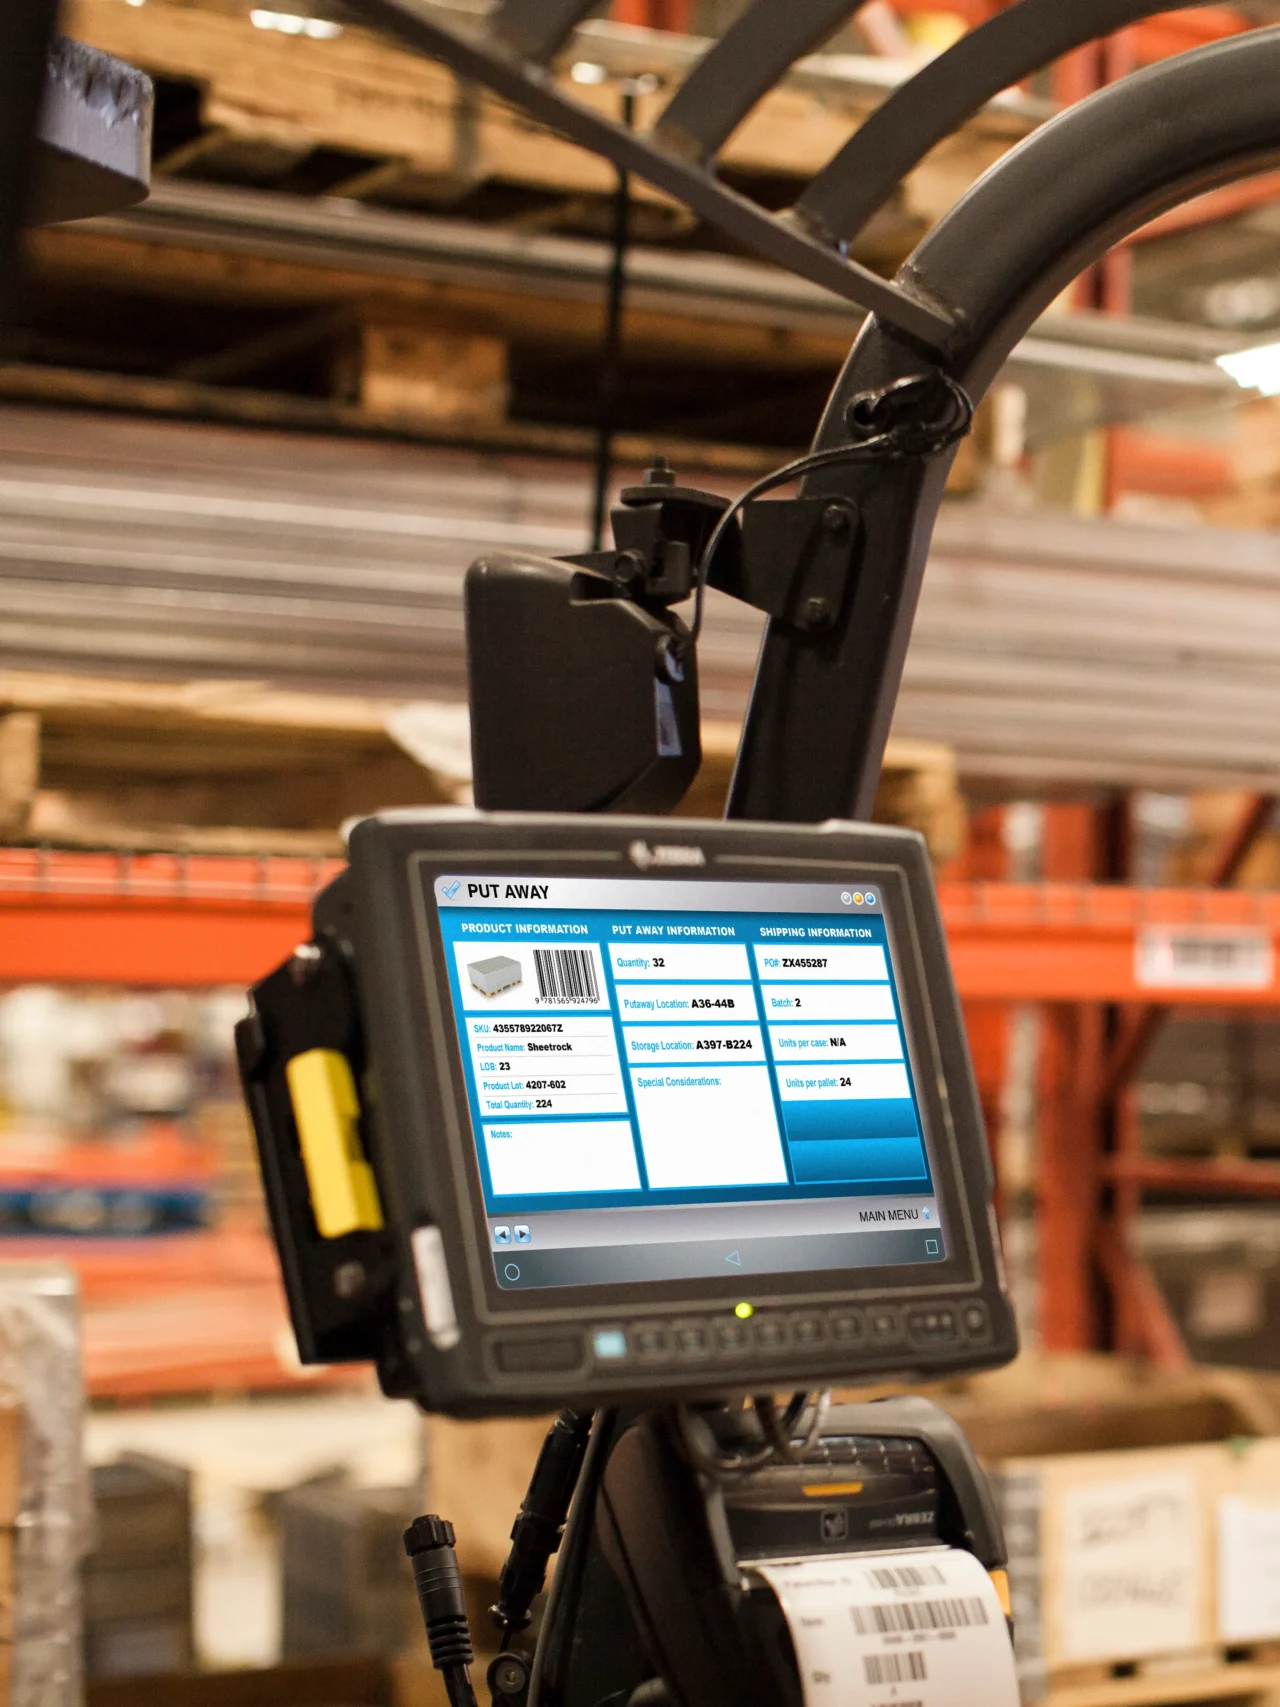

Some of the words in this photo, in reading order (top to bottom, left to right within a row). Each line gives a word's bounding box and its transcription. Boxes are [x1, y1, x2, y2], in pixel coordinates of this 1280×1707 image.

[467, 884, 499, 898] PUT
[505, 885, 549, 899] AWAY
[461, 923, 512, 934] PRODUCT
[515, 923, 589, 935] INFORMATION
[612, 925, 632, 935] PUT
[636, 926, 664, 936] AWAY
[667, 926, 736, 936] INFORMATION
[760, 927, 805, 938] SHIPPING
[808, 927, 872, 938] INFORMATION
[617, 957, 650, 969] Quantity:
[652, 958, 665, 967] 32
[764, 958, 781, 967] PO#:
[782, 958, 827, 968] ZX455287
[624, 999, 655, 1010] Putaway
[656, 999, 689, 1009] Location:
[691, 999, 735, 1008] A36-44B
[771, 998, 793, 1007] Batch:
[795, 998, 801, 1007] 2
[474, 1025, 491, 1033] SKU:
[493, 1024, 563, 1033] 435578922067Z
[477, 1044, 503, 1052] Product
[527, 1043, 572, 1051] Sheetrock
[631, 1041, 659, 1052] Storage
[661, 1041, 694, 1050] Location:
[696, 1040, 752, 1050] A397-B224
[779, 1038, 797, 1047] Units
[798, 1040, 809, 1049] per
[830, 1038, 847, 1047] N/A
[480, 1062, 497, 1071] LOB:
[499, 1062, 510, 1071] 23
[483, 1082, 509, 1090] Product
[511, 1081, 524, 1090] Lot:
[526, 1080, 566, 1089] 4207-602
[637, 1078, 664, 1089] Special
[666, 1077, 721, 1087] Considerations:
[786, 1079, 804, 1088] Units
[805, 1080, 816, 1088] per
[818, 1078, 839, 1089] pallet:
[840, 1078, 852, 1087] 24
[486, 1100, 503, 1109] Total
[504, 1100, 534, 1110] Quantity:
[536, 1099, 552, 1108] 224
[491, 1130, 512, 1138] Notes:
[859, 1210, 886, 1222] MAIN
[888, 1209, 919, 1221] MENU
